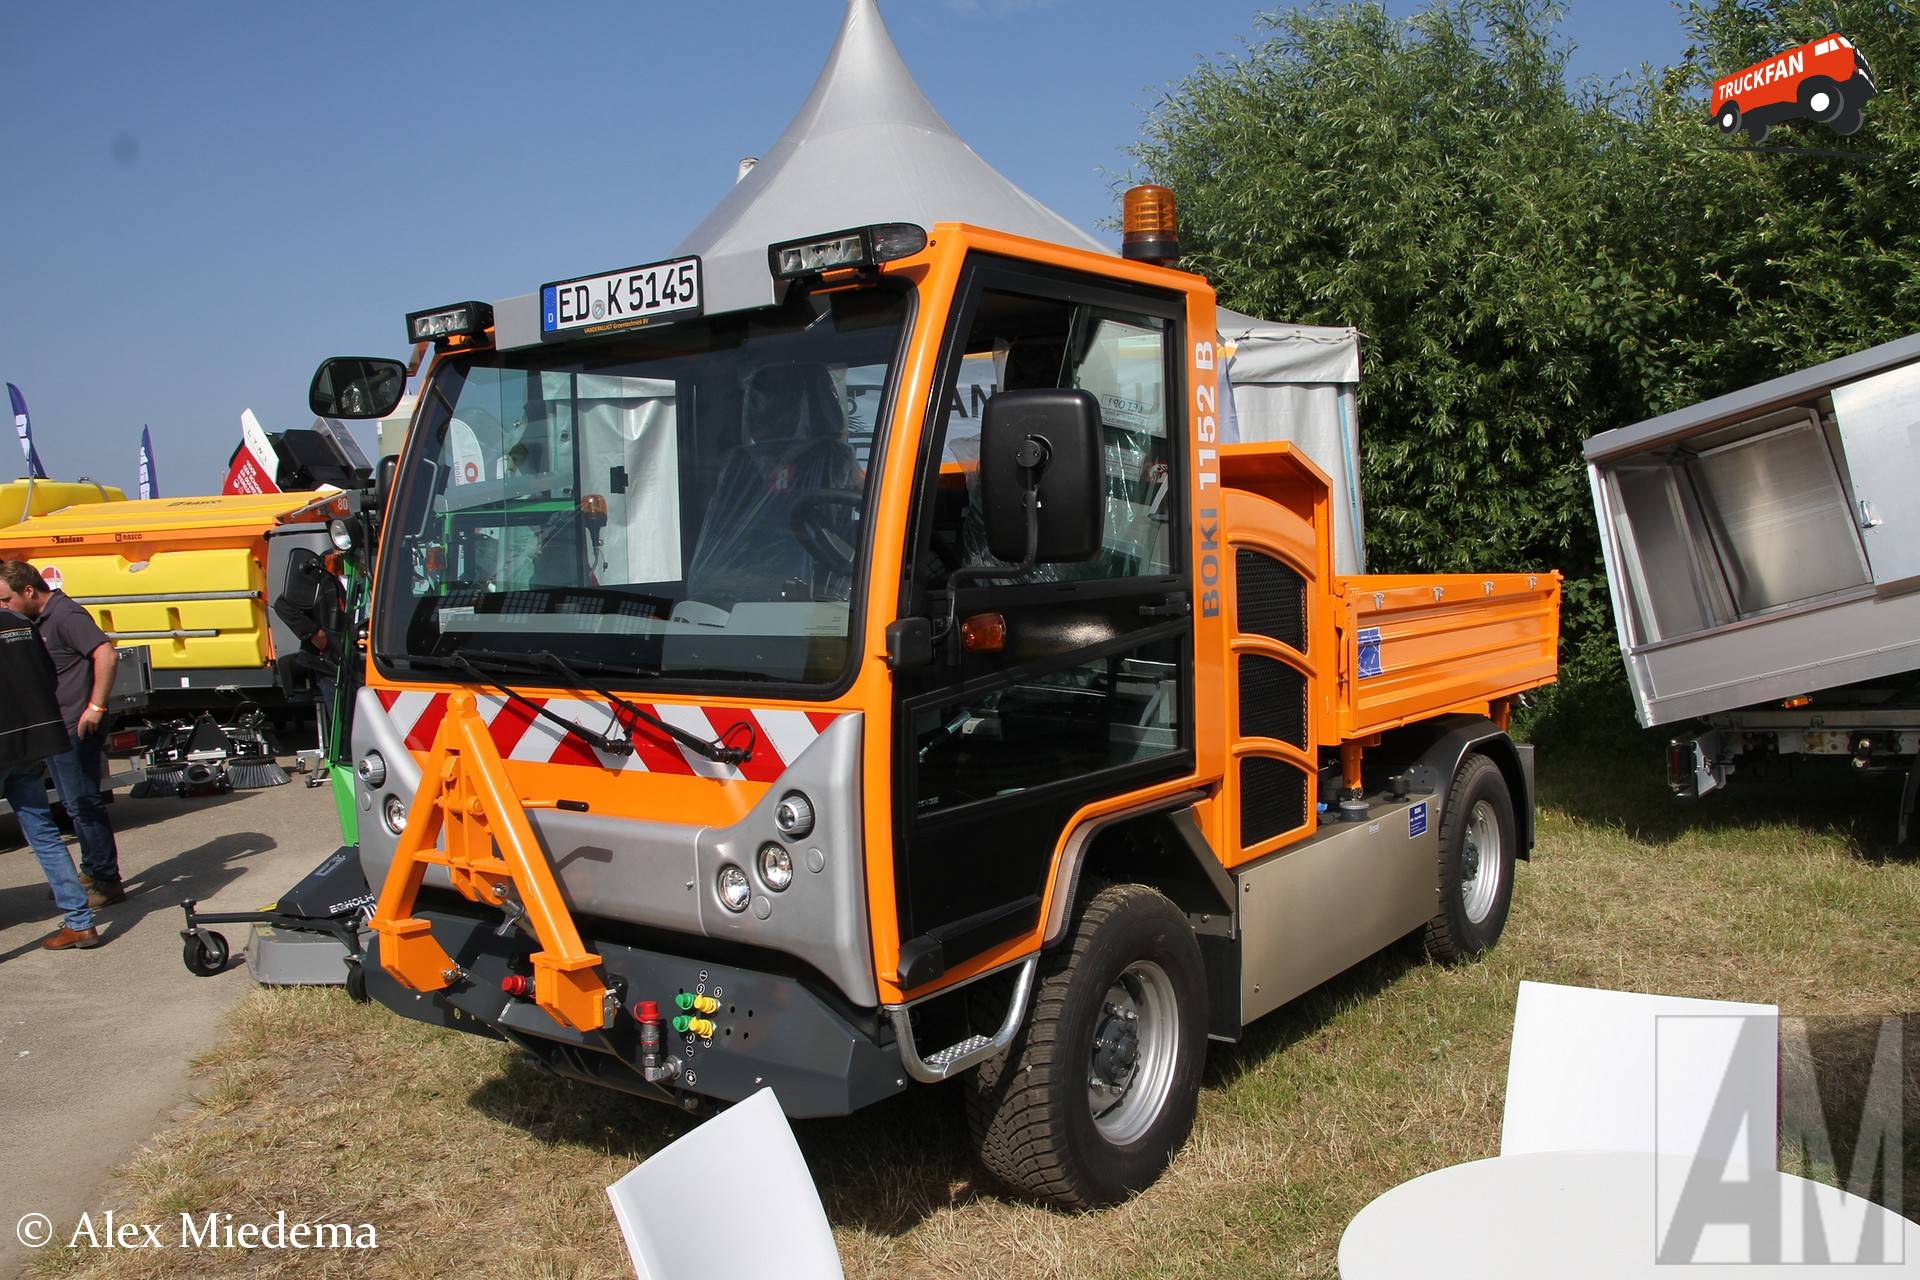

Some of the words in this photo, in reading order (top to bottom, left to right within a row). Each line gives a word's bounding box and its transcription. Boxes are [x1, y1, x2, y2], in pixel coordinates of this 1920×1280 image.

[559, 285, 589, 323] ED
[607, 278, 623, 316] K
[629, 264, 694, 311] 5145
[548, 313, 554, 323] D
[1196, 341, 1213, 370] B
[1197, 384, 1217, 490] 1152
[338, 498, 348, 510] 80
[1200, 508, 1219, 618] BOKI
